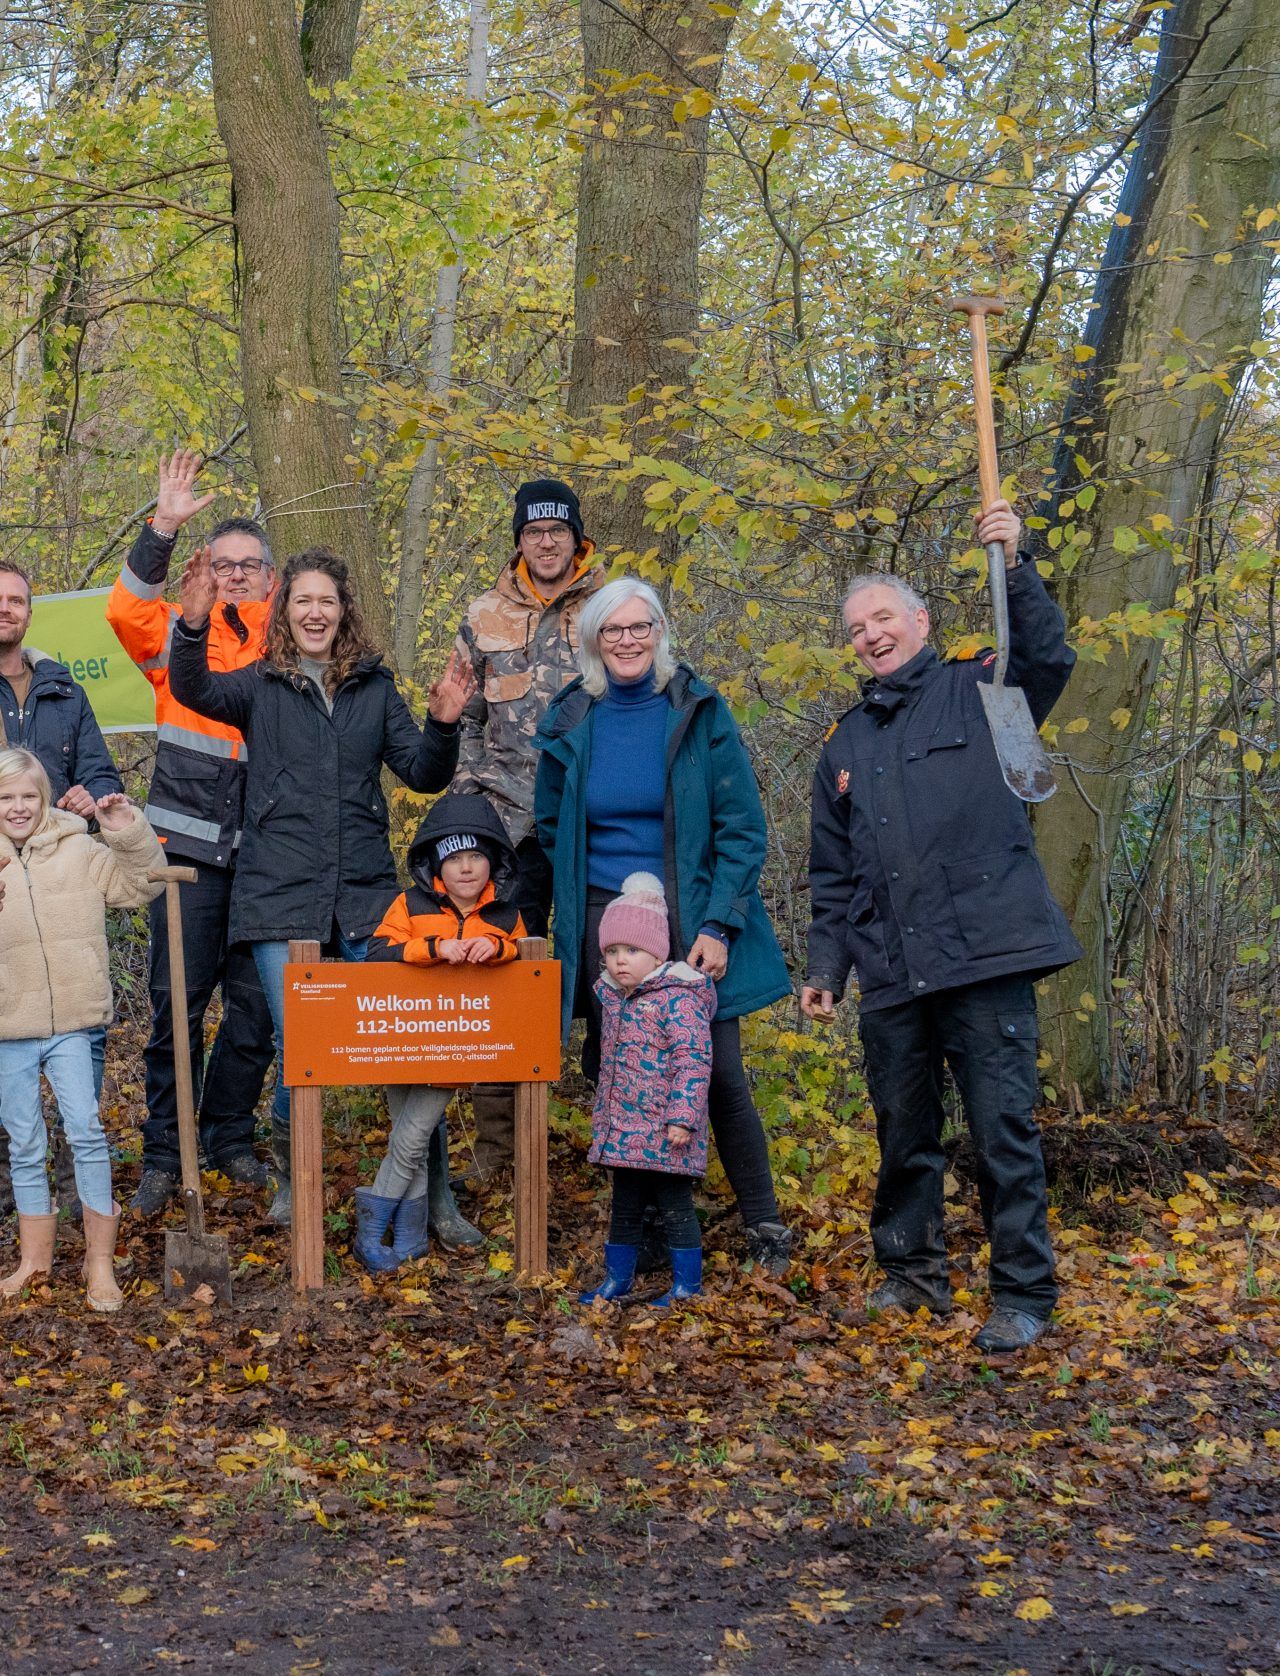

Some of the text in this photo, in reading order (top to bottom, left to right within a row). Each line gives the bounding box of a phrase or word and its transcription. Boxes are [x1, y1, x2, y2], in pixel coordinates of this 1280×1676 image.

[527, 502, 569, 520] HATSEFLATS
[356, 994, 491, 1012] Welkom in het
[356, 1016, 491, 1035] 112-bomenbos
[372, 1045, 400, 1054] geplant
[421, 1043, 478, 1053] Veiligheidsregio
[348, 1055, 373, 1063] Samen
